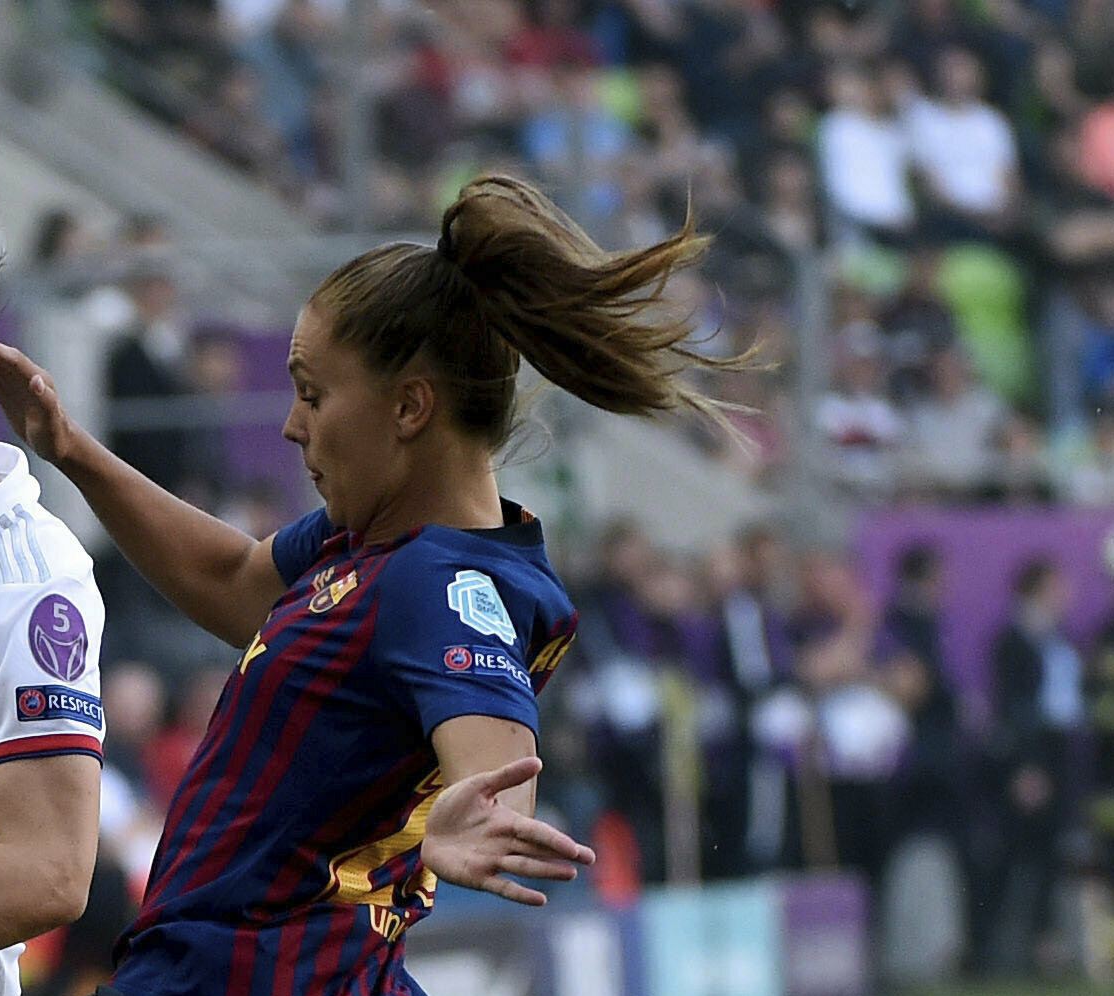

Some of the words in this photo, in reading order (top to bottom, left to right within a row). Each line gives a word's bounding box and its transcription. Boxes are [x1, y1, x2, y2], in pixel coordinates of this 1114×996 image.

[52, 602, 71, 633] 5
[474, 653, 532, 689] RESPECT
[48, 694, 102, 720] RESPECT
